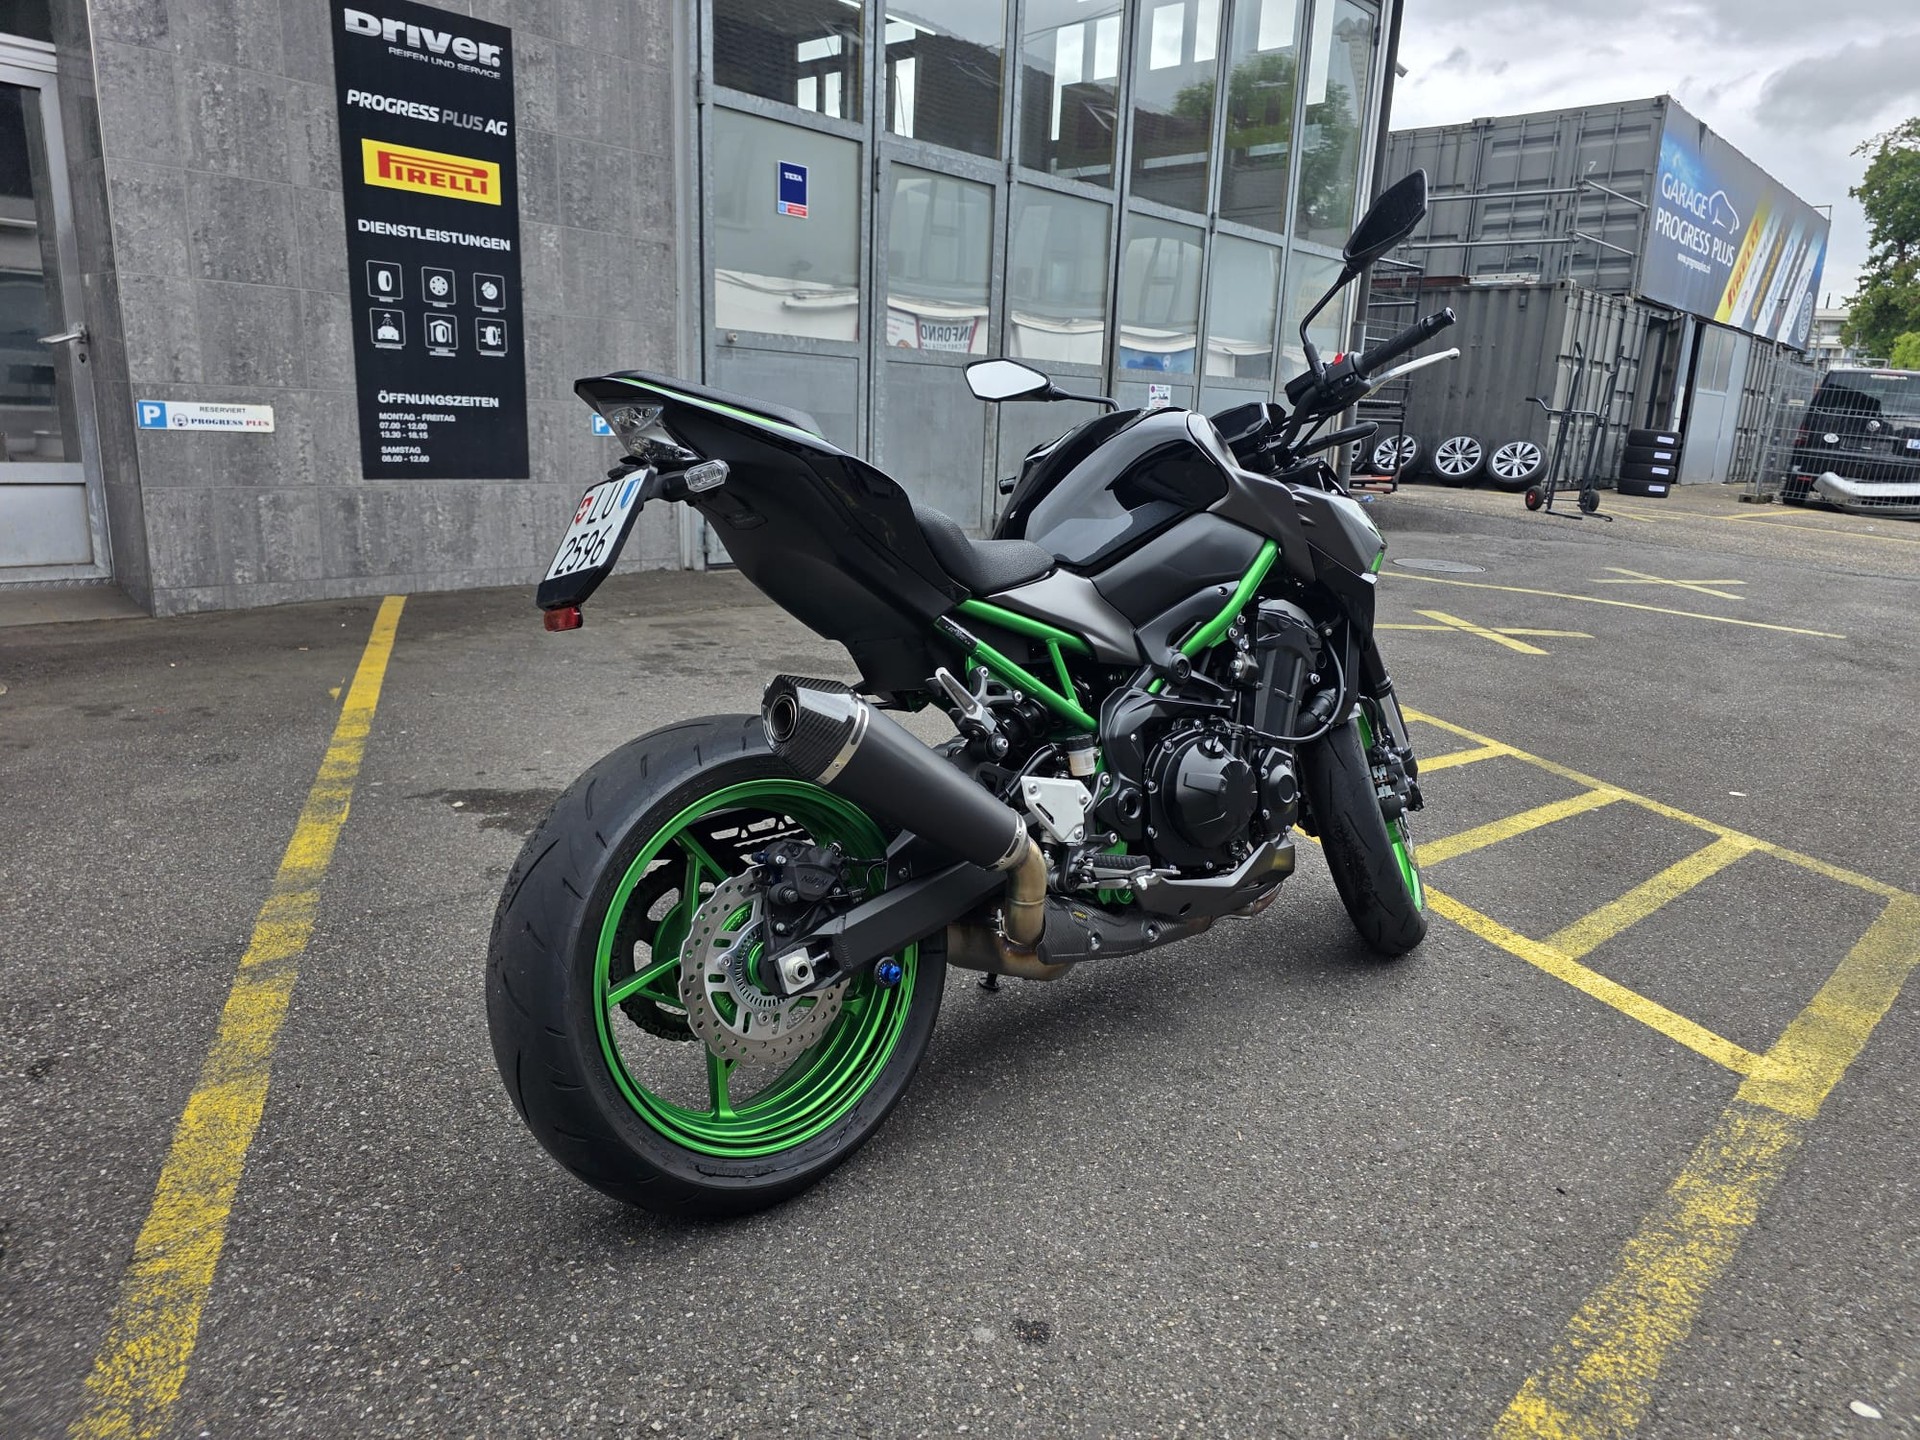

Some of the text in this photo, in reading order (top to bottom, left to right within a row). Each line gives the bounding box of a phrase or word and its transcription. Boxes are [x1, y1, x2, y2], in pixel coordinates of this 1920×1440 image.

[388, 47, 501, 80] REIFEN UND SERVICE
[347, 89, 508, 136] PROGRESS PLUS AG
[377, 150, 488, 195] PIRELLI
[1662, 173, 1708, 220] GARAGE
[358, 219, 511, 251] DIENSTLEISTUNGEN
[1656, 207, 1711, 255] PROGRESS
[1711, 236, 1736, 268] PLUS
[143, 405, 161, 424] P
[378, 390, 499, 408] ÖFFNUNGSZEITEN
[191, 418, 244, 426] PROGRESS
[379, 412, 416, 421] MONTAG
[421, 413, 456, 422] FREITAG
[379, 422, 401, 430] 07.00
[407, 422, 428, 430] 12.00
[381, 446, 421, 454] SAMSTAG
[409, 455, 430, 463] 12.00
[587, 479, 626, 524] LU
[554, 524, 613, 576] 2596
